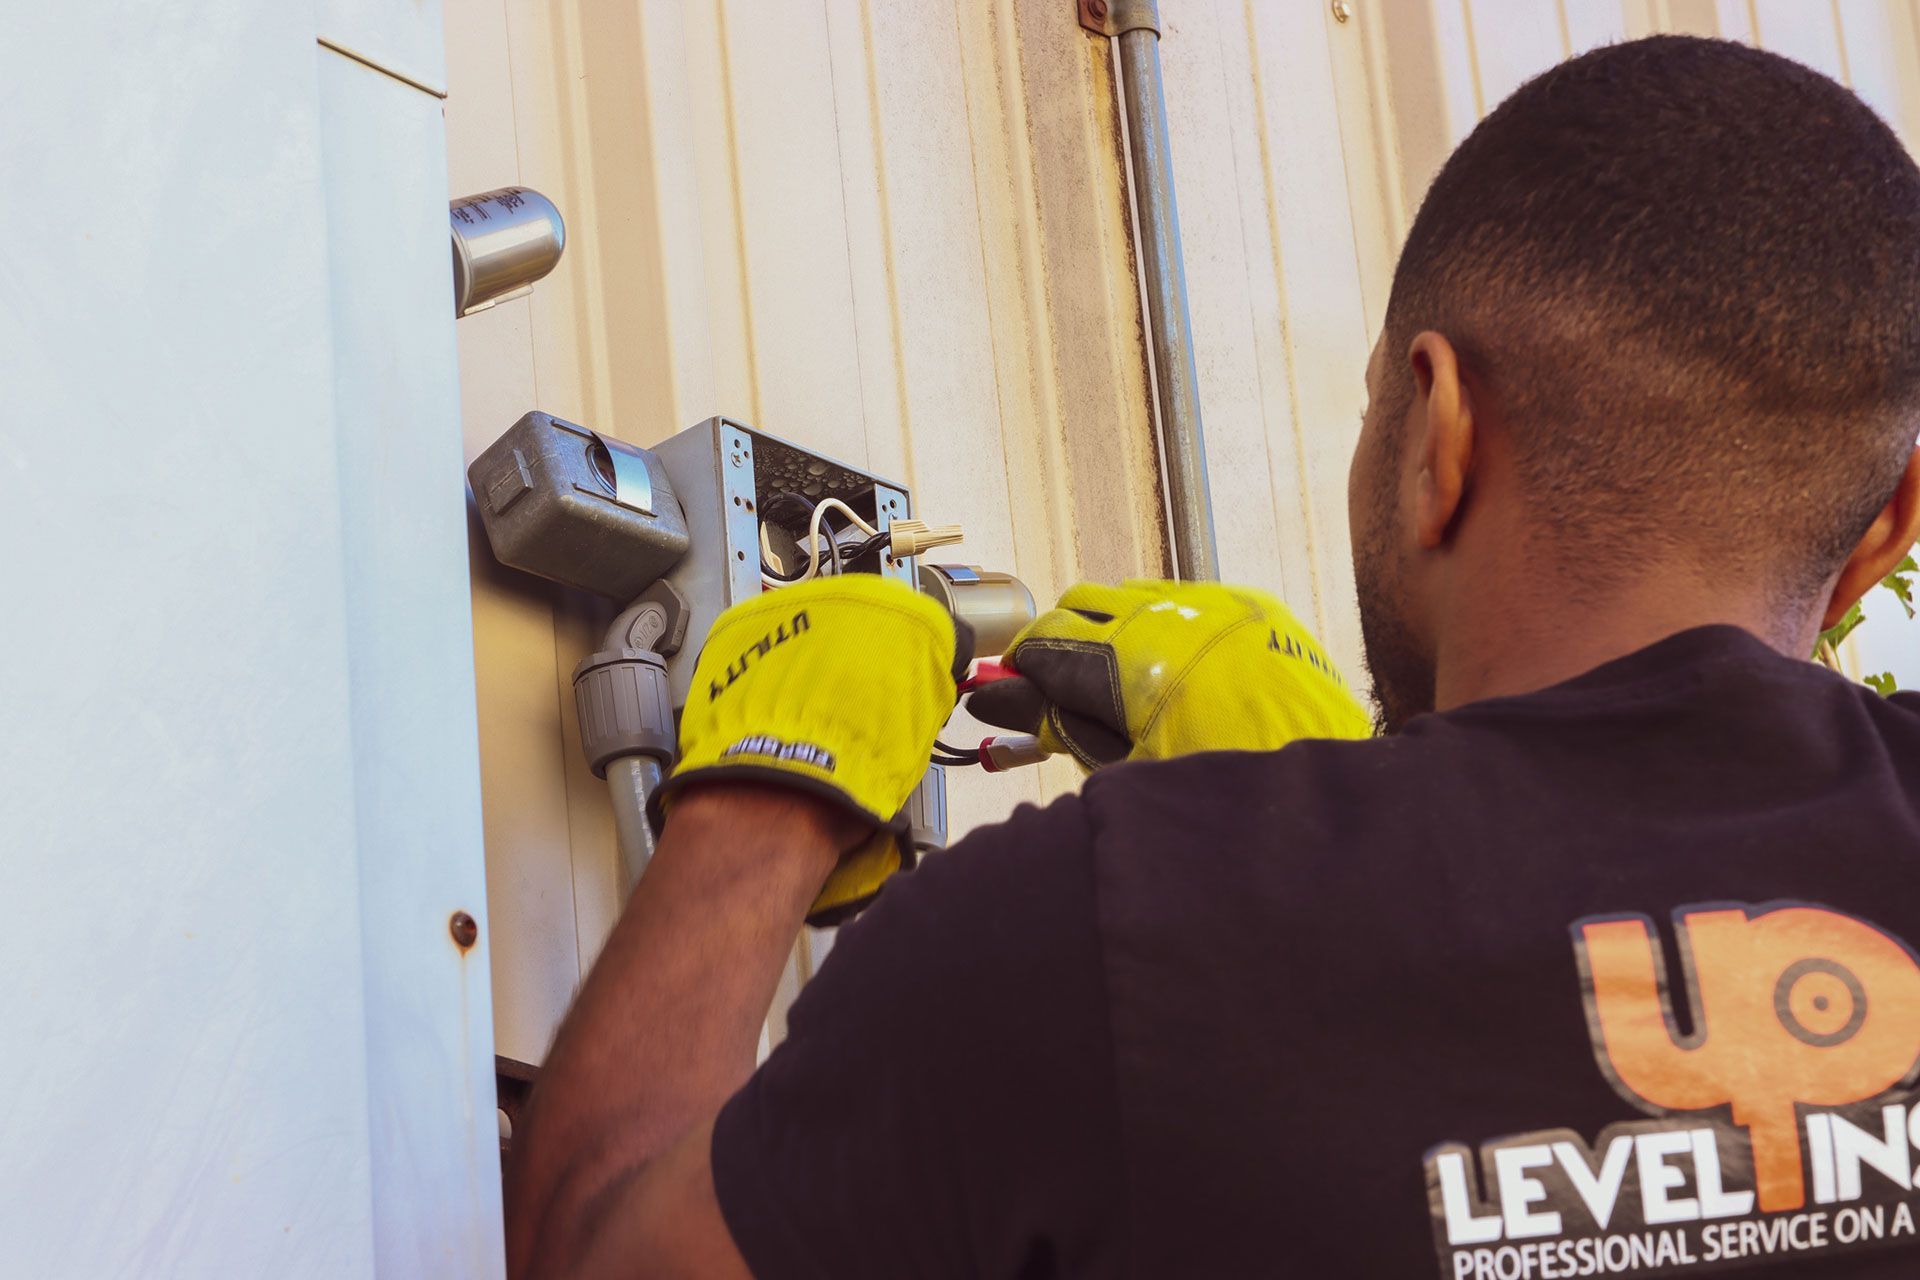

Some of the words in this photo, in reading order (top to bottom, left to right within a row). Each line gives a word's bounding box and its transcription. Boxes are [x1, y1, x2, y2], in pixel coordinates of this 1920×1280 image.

[709, 609, 811, 702] UTILITY
[1437, 1128, 1755, 1245] LEVEL
[1806, 1103, 1920, 1205] IN
[1452, 1228, 1698, 1280] PROFESSIONAL
[1702, 1211, 1829, 1262] SERVICE
[1834, 1204, 1885, 1244] ON
[1891, 1201, 1915, 1237] A
